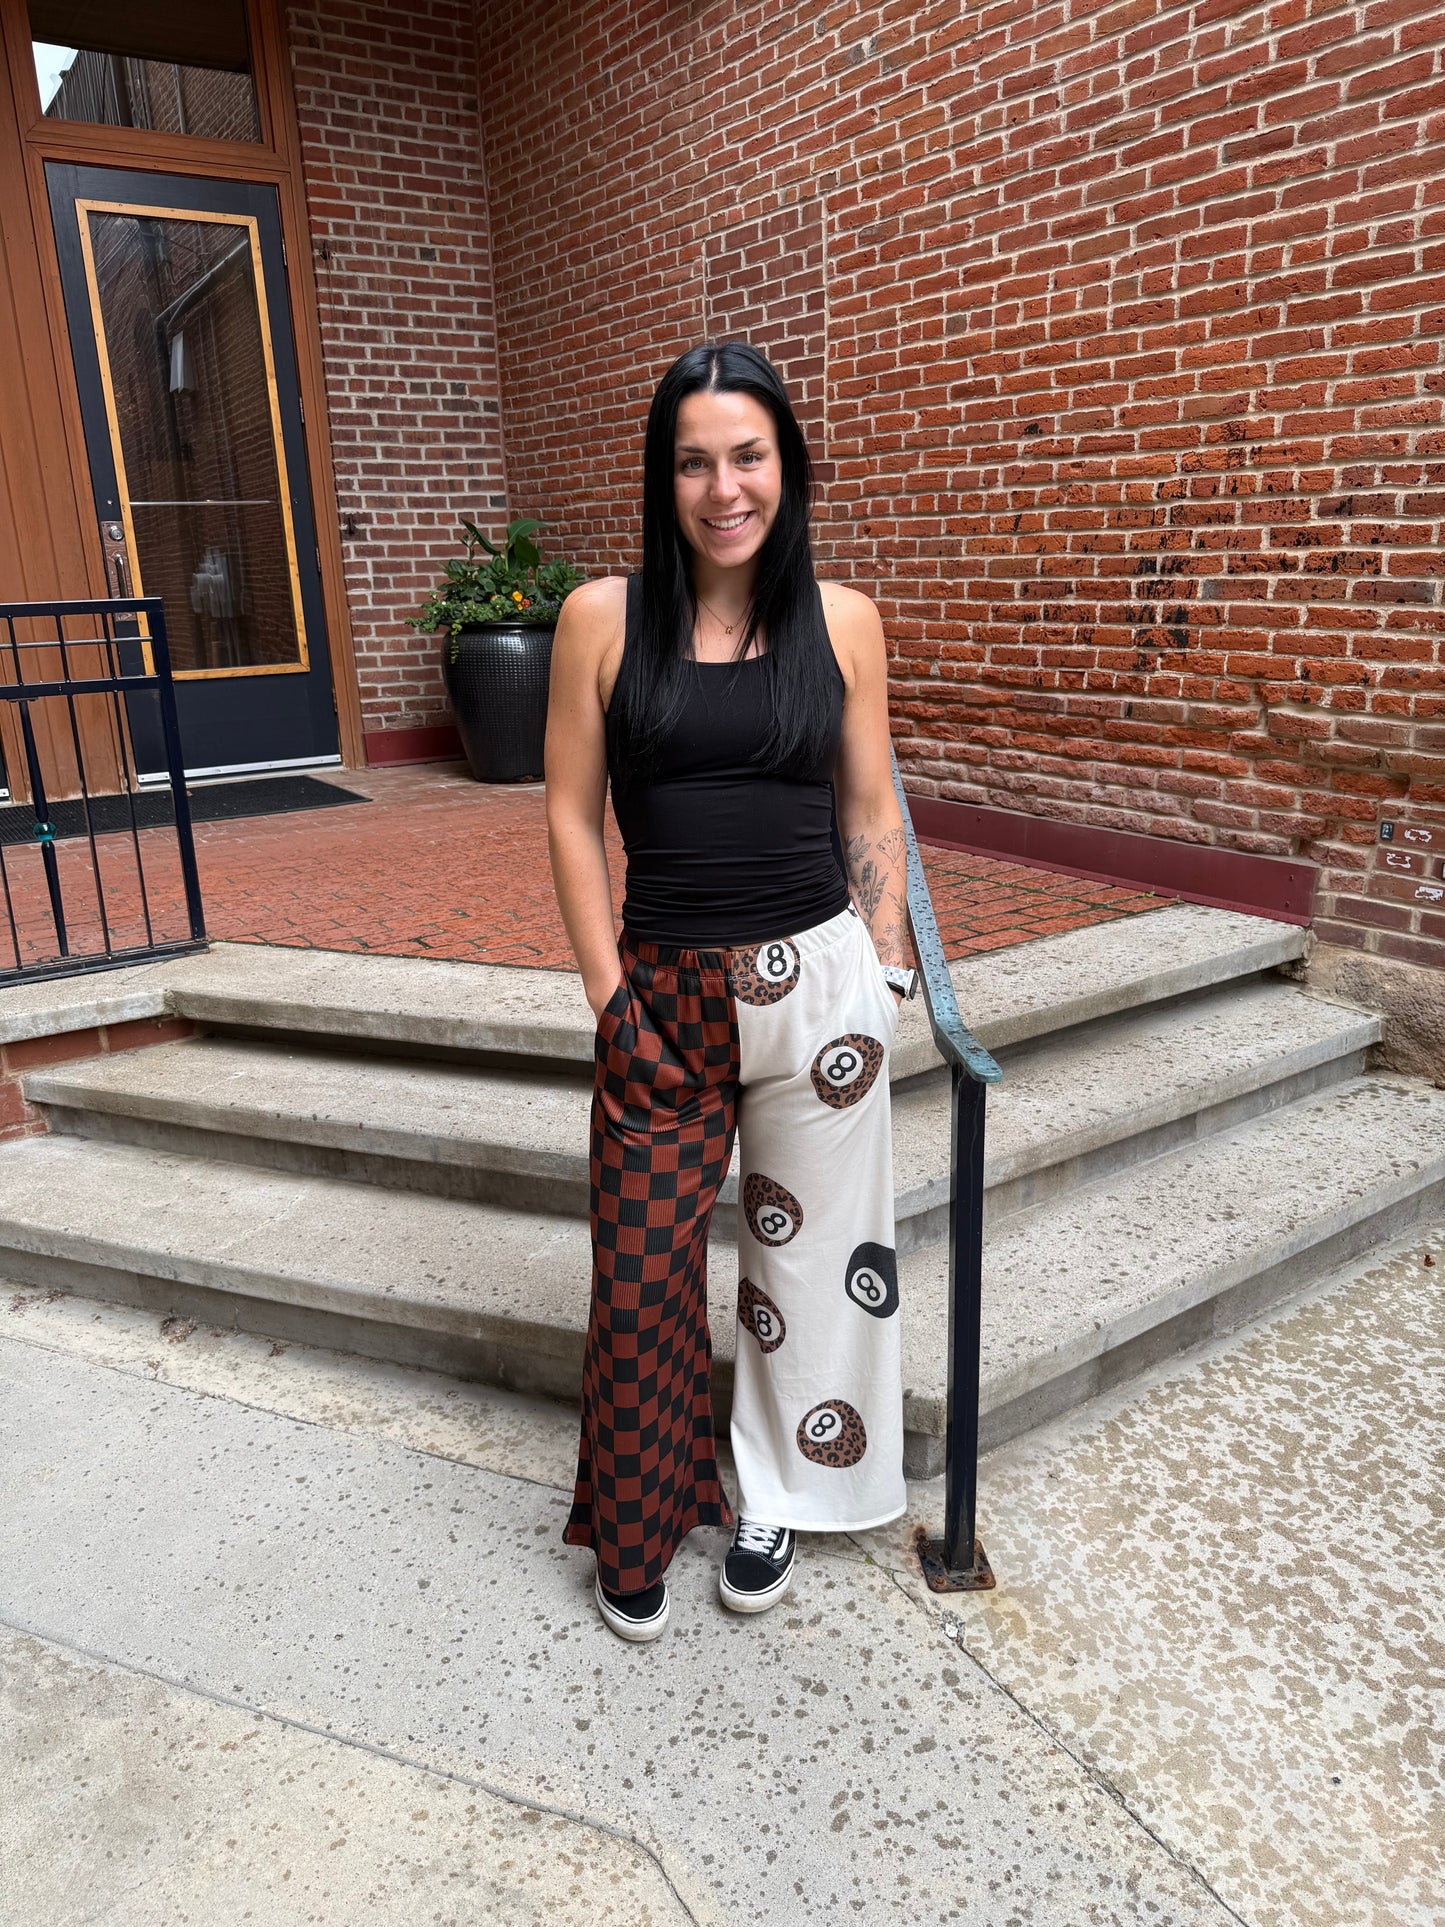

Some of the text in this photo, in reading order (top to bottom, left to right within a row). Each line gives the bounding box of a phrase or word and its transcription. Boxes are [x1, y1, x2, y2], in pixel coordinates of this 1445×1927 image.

[766, 943, 787, 977] 8
[828, 1051, 857, 1080] 8
[761, 1212, 787, 1235] 8
[856, 1272, 881, 1302] 8
[756, 1309, 772, 1337] 8
[811, 1412, 836, 1438] 8
